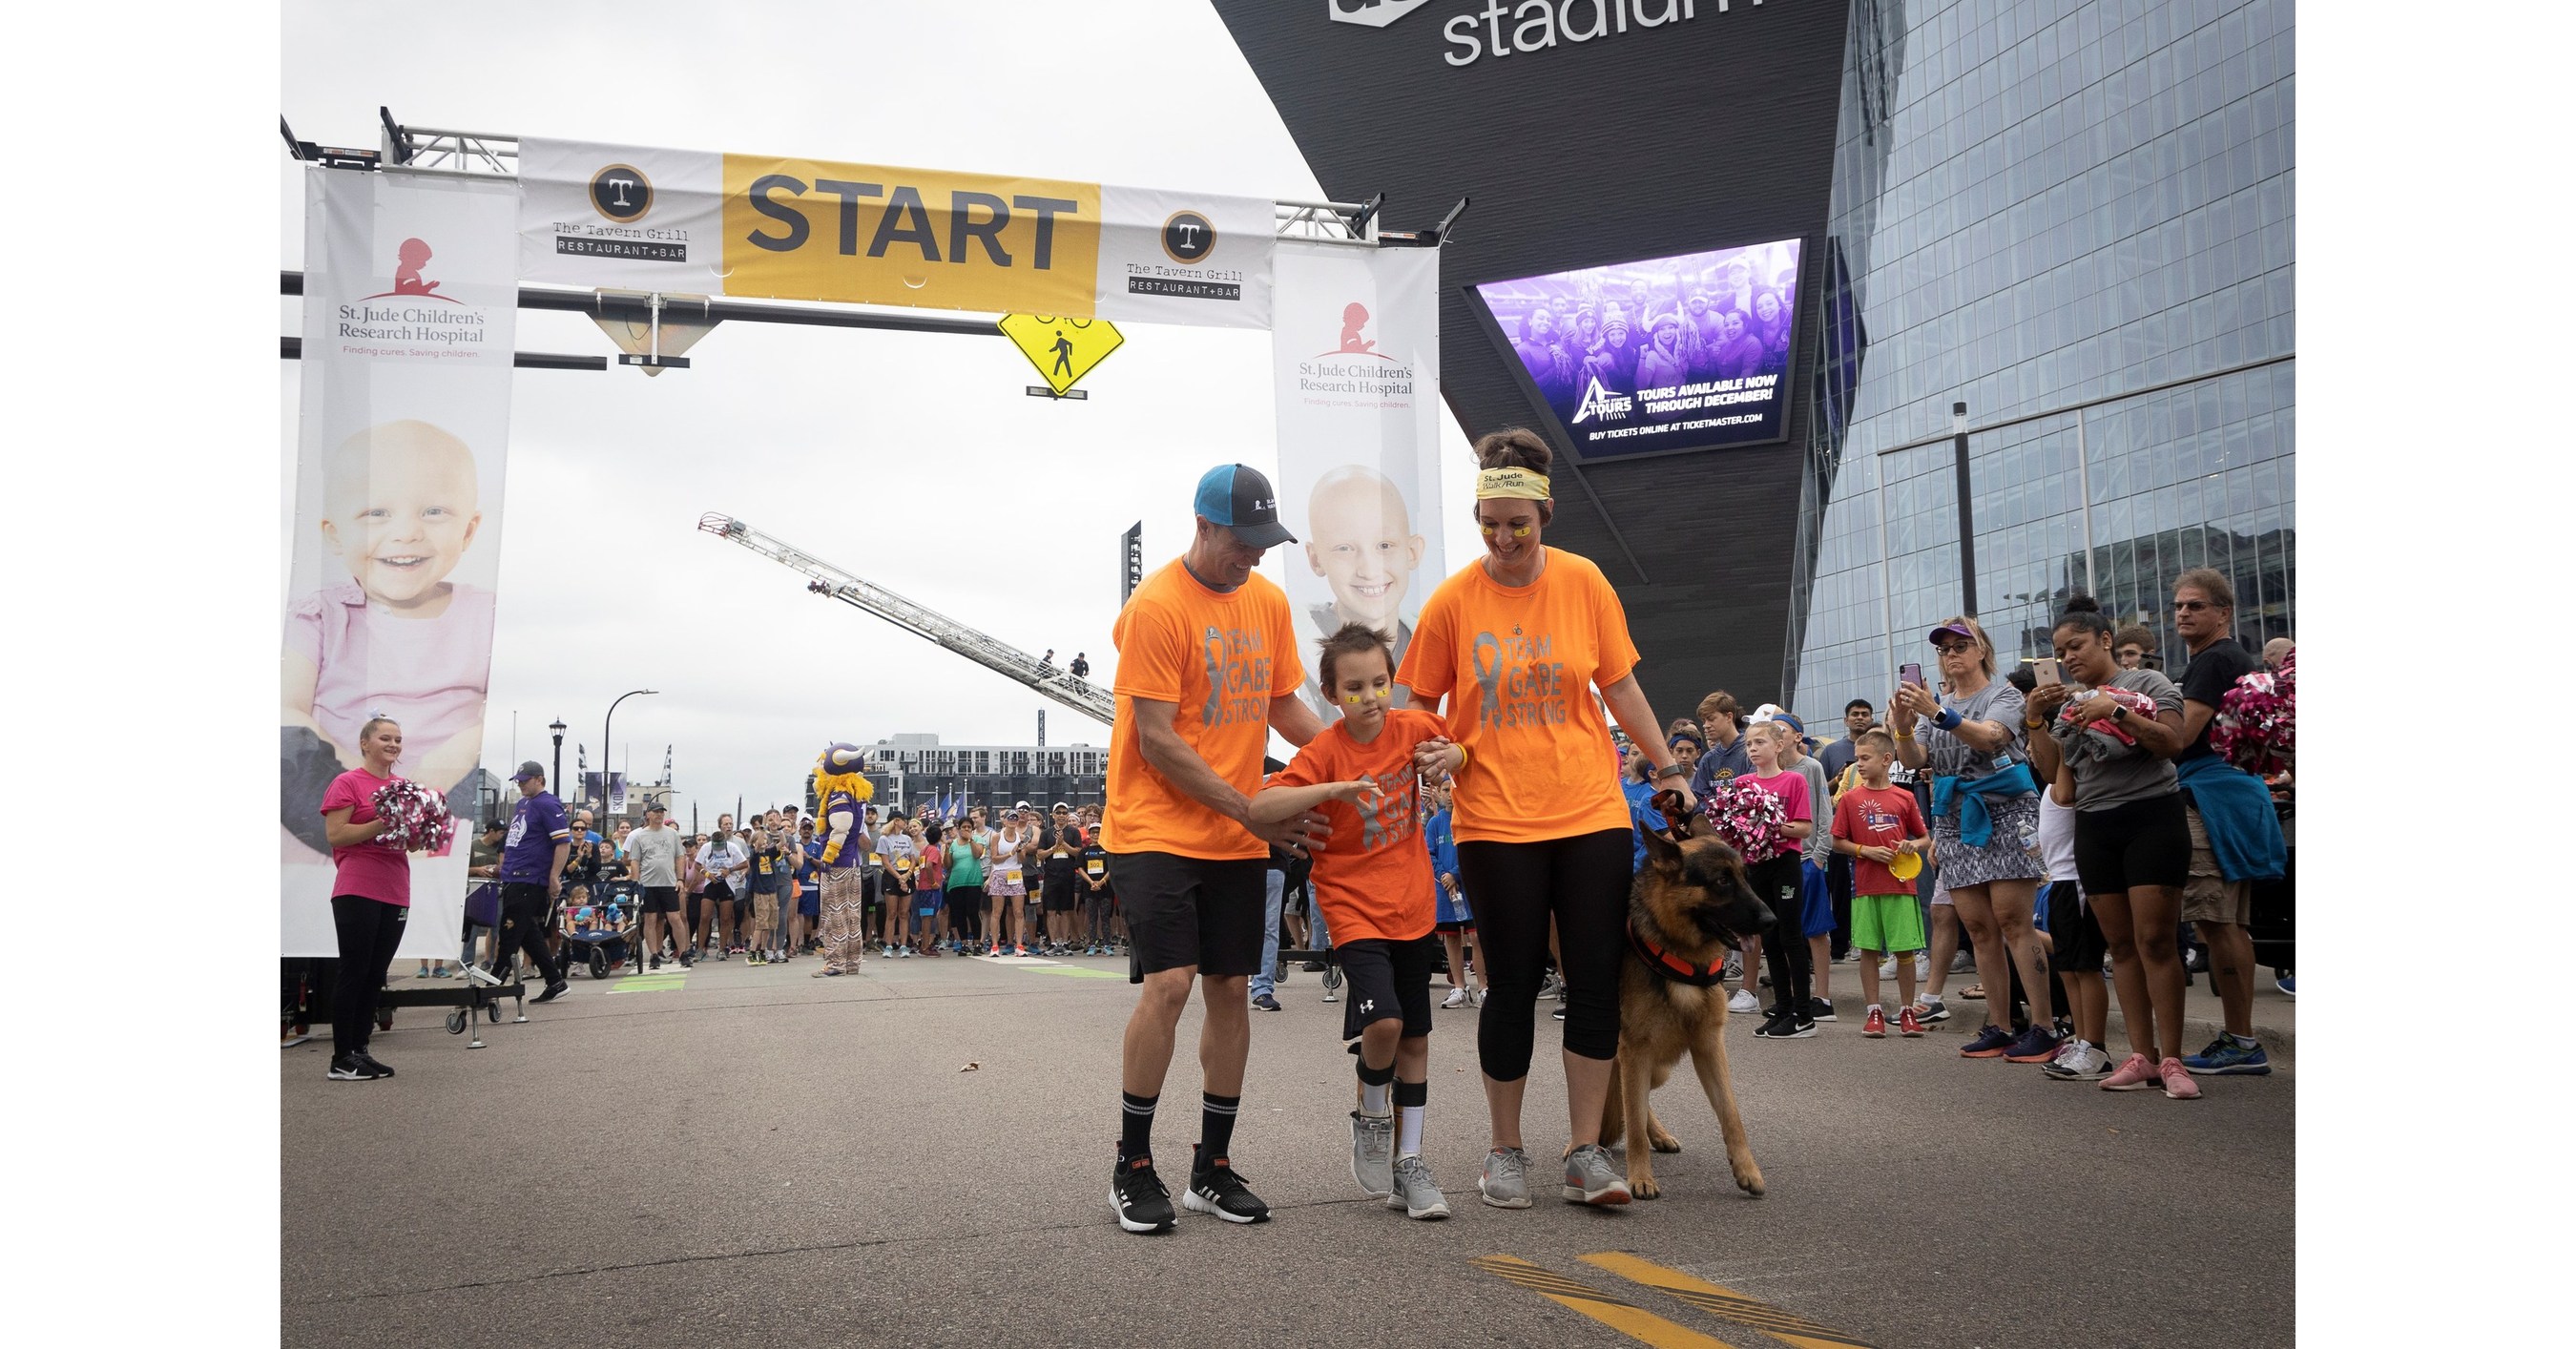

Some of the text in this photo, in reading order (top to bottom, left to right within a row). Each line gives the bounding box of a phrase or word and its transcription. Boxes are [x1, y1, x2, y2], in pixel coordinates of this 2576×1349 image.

[1443, 0, 1763, 67] stadiu
[608, 177, 634, 207] T
[552, 221, 691, 242] The Tavern Grill
[746, 174, 1079, 271] START
[1178, 222, 1201, 250] T
[557, 239, 686, 259] RESTAURANT+BAR
[1127, 262, 1245, 282] The Tavern Grill
[1129, 280, 1240, 297] RESTAURANT+BAR
[339, 304, 485, 325] St. Jude Children's
[339, 322, 484, 345] Research Hospital
[343, 345, 481, 360] Finding cures. Saving children.
[1298, 362, 1413, 380] St. Jude Children's
[1299, 378, 1413, 398] Research Hospital
[1636, 385, 1676, 403] TOURS
[1677, 378, 1745, 397] AVAILABLE
[1744, 373, 1778, 389] NOW
[1645, 396, 1703, 414] THROUGH
[1703, 387, 1775, 408] DECEMBER!
[1303, 397, 1331, 407] Finding
[1354, 400, 1379, 409] Saving
[1380, 401, 1411, 409] children.
[1588, 400, 1632, 416] TOURS
[1589, 413, 1763, 442] BUY TICKETS ONLINE AT TICKETMASTER.COM
[1484, 471, 1524, 483] St. Jude
[1226, 628, 1263, 655] TEAM
[1504, 633, 1552, 661] TEAM
[1225, 656, 1271, 695] GABE
[1507, 662, 1564, 698] GABE
[1506, 698, 1567, 728] STRONG
[1379, 763, 1414, 795] TEAM
[613, 792, 624, 812] SKOL
